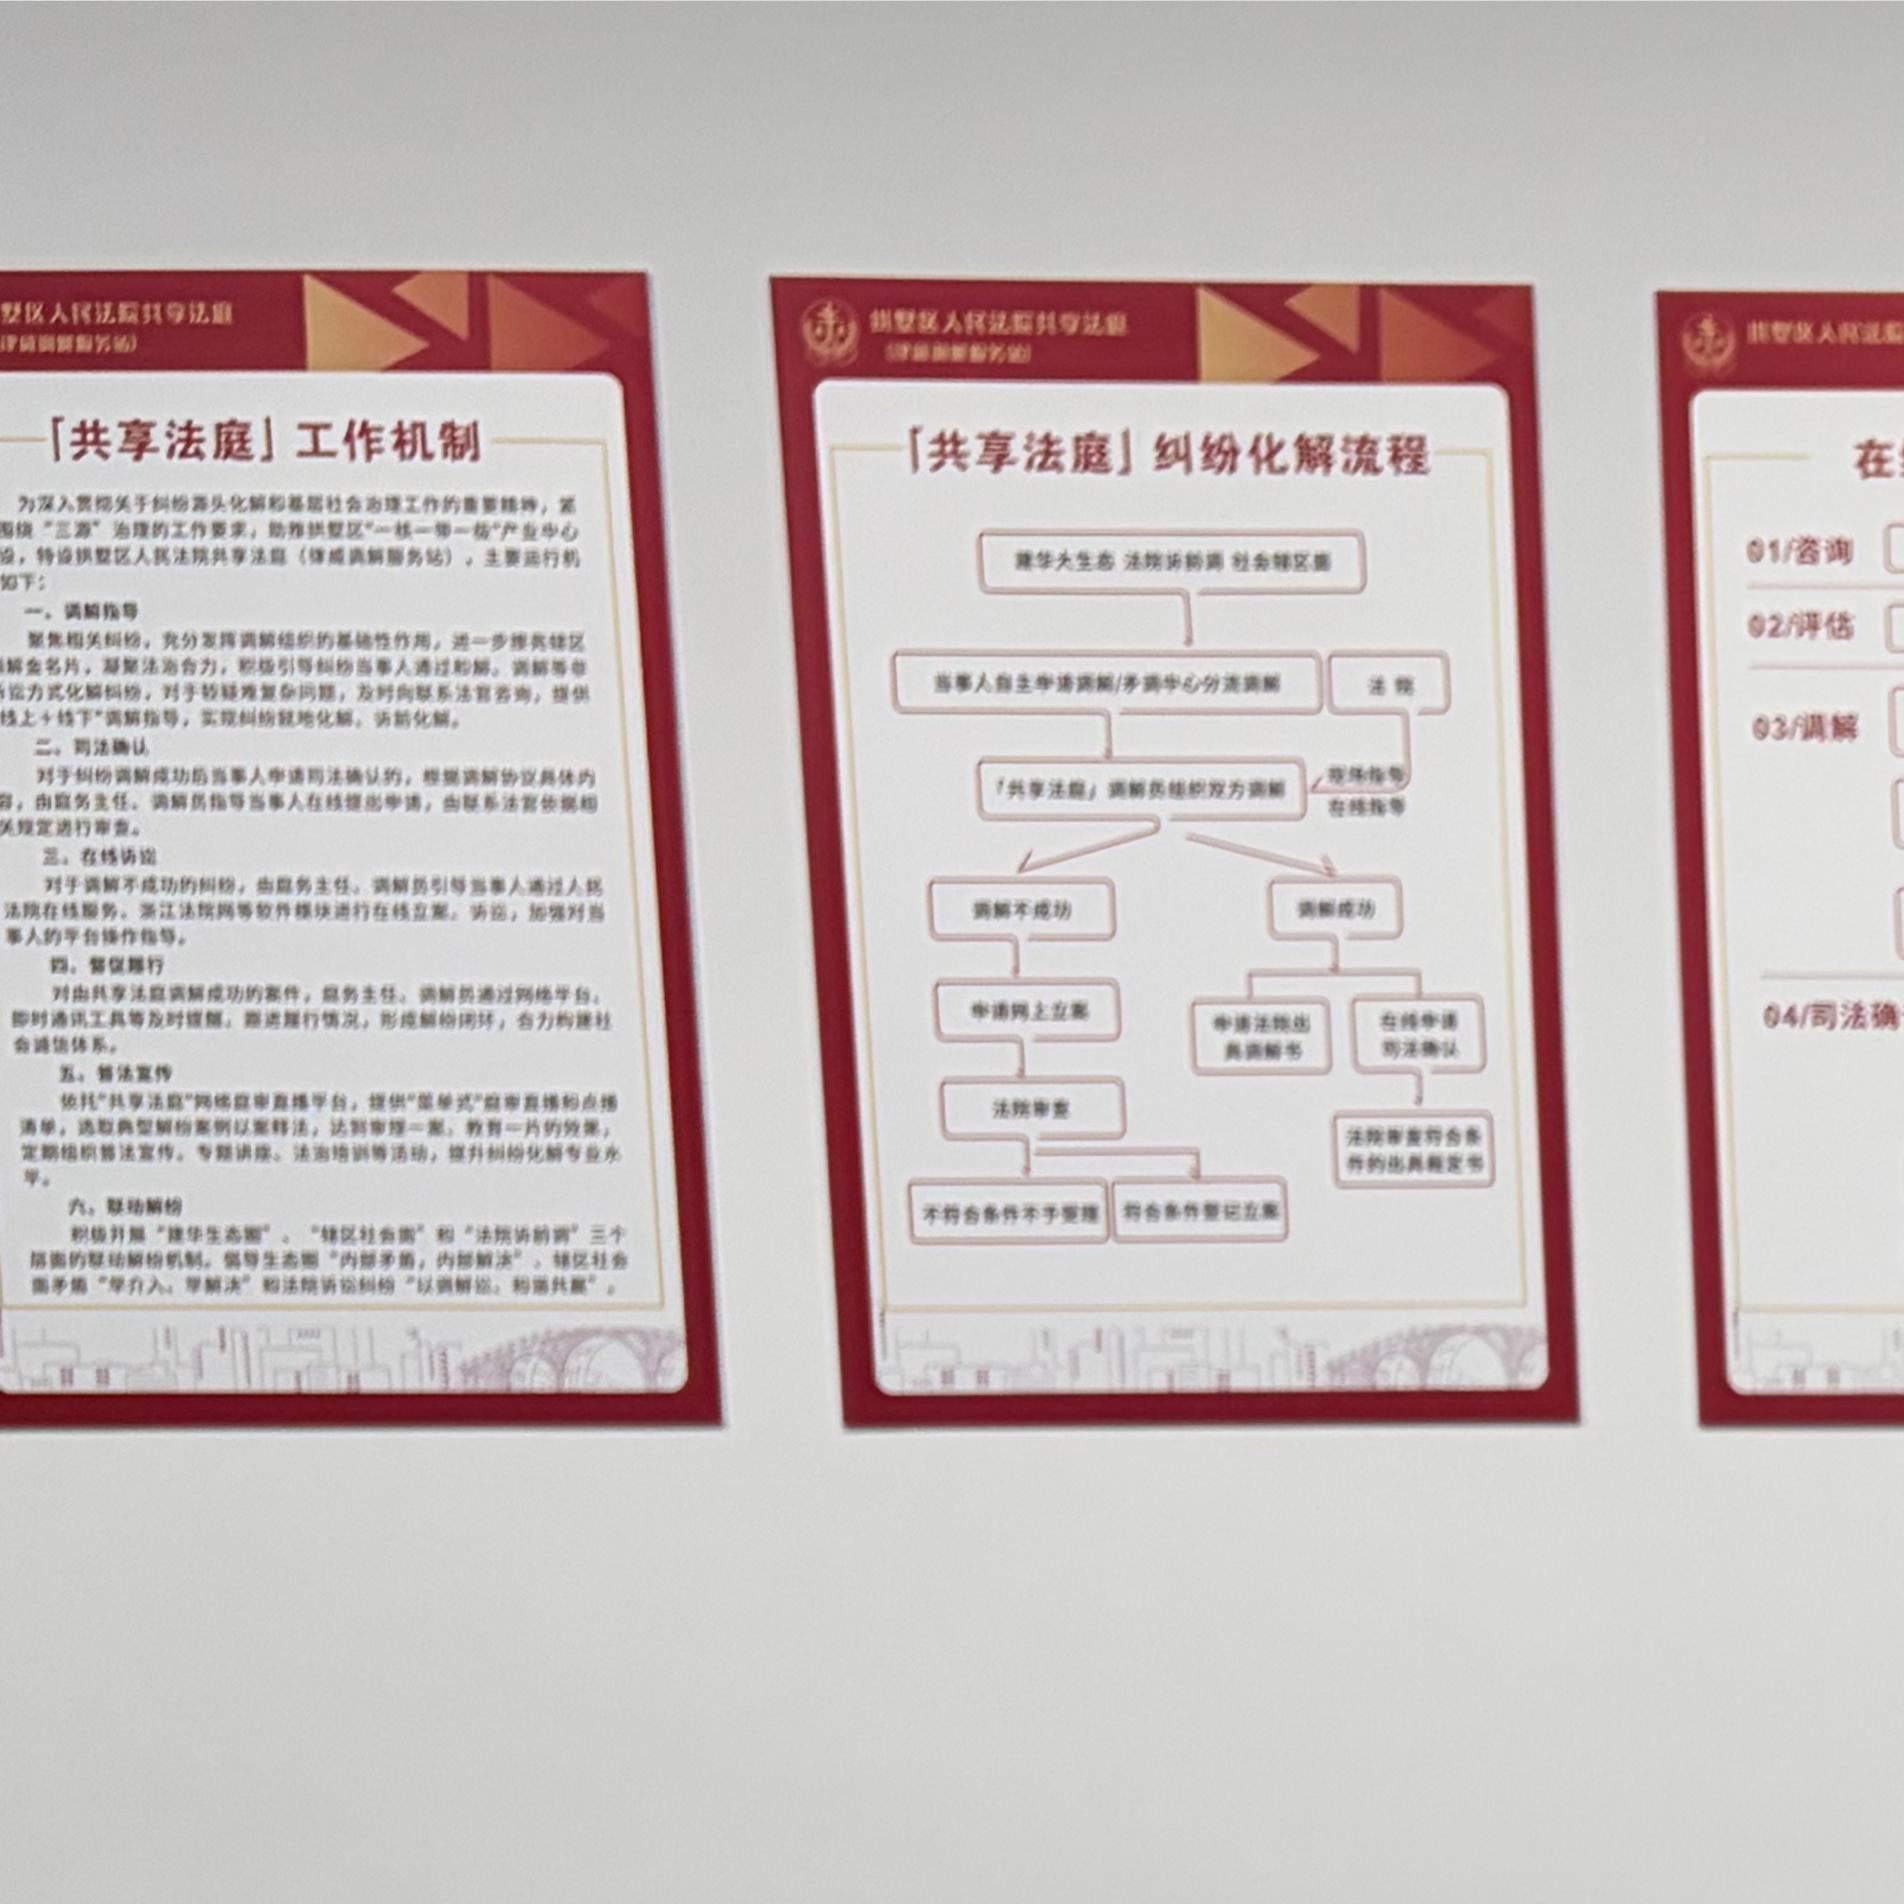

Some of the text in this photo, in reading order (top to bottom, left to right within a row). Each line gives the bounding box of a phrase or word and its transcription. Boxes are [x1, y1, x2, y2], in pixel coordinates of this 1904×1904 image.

[52, 416, 480, 462] 「共享法庭」工作机制
[910, 427, 1429, 476] 「共享法庭」纠纷化解流程
[1747, 536, 1853, 565] 01/咨询
[1748, 611, 1854, 640] 02/评估
[1753, 714, 1858, 742] 03/调解
[994, 1099, 1069, 1119] 法院审查
